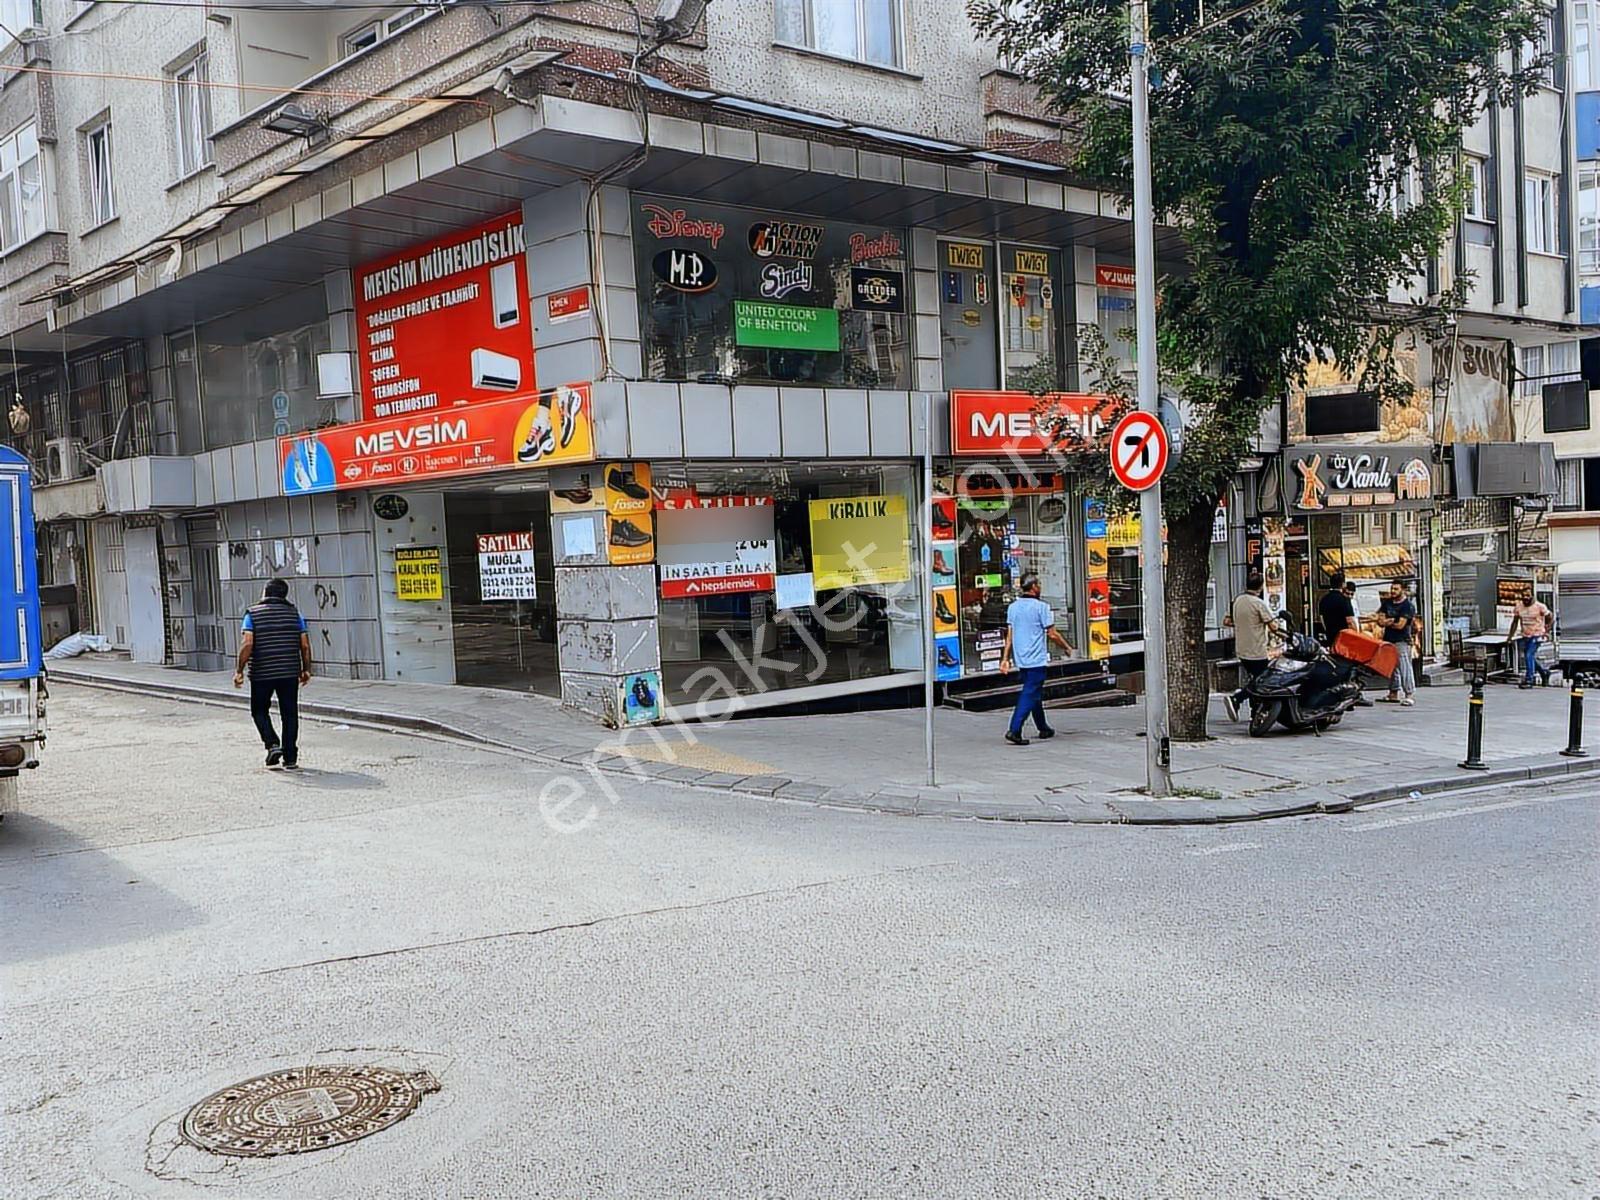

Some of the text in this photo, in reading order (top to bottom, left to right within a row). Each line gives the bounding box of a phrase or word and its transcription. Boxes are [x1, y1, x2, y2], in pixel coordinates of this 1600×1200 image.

[641, 203, 725, 249] Disney
[769, 221, 825, 243] ACTION
[776, 239, 817, 259] MAN
[950, 246, 982, 268] TWIGY
[363, 222, 526, 301] MEVSİM MÜHENDİSLİK
[1017, 253, 1047, 273] TWIGY
[760, 260, 813, 299] Sindy
[737, 303, 817, 321] UNITED COLORS
[738, 317, 753, 329] OF
[355, 416, 468, 457] MEVSİM
[1336, 454, 1392, 489] Namlı
[479, 534, 531, 552] SATILIK
[665, 562, 772, 579] İNŞAAT EMLAK
